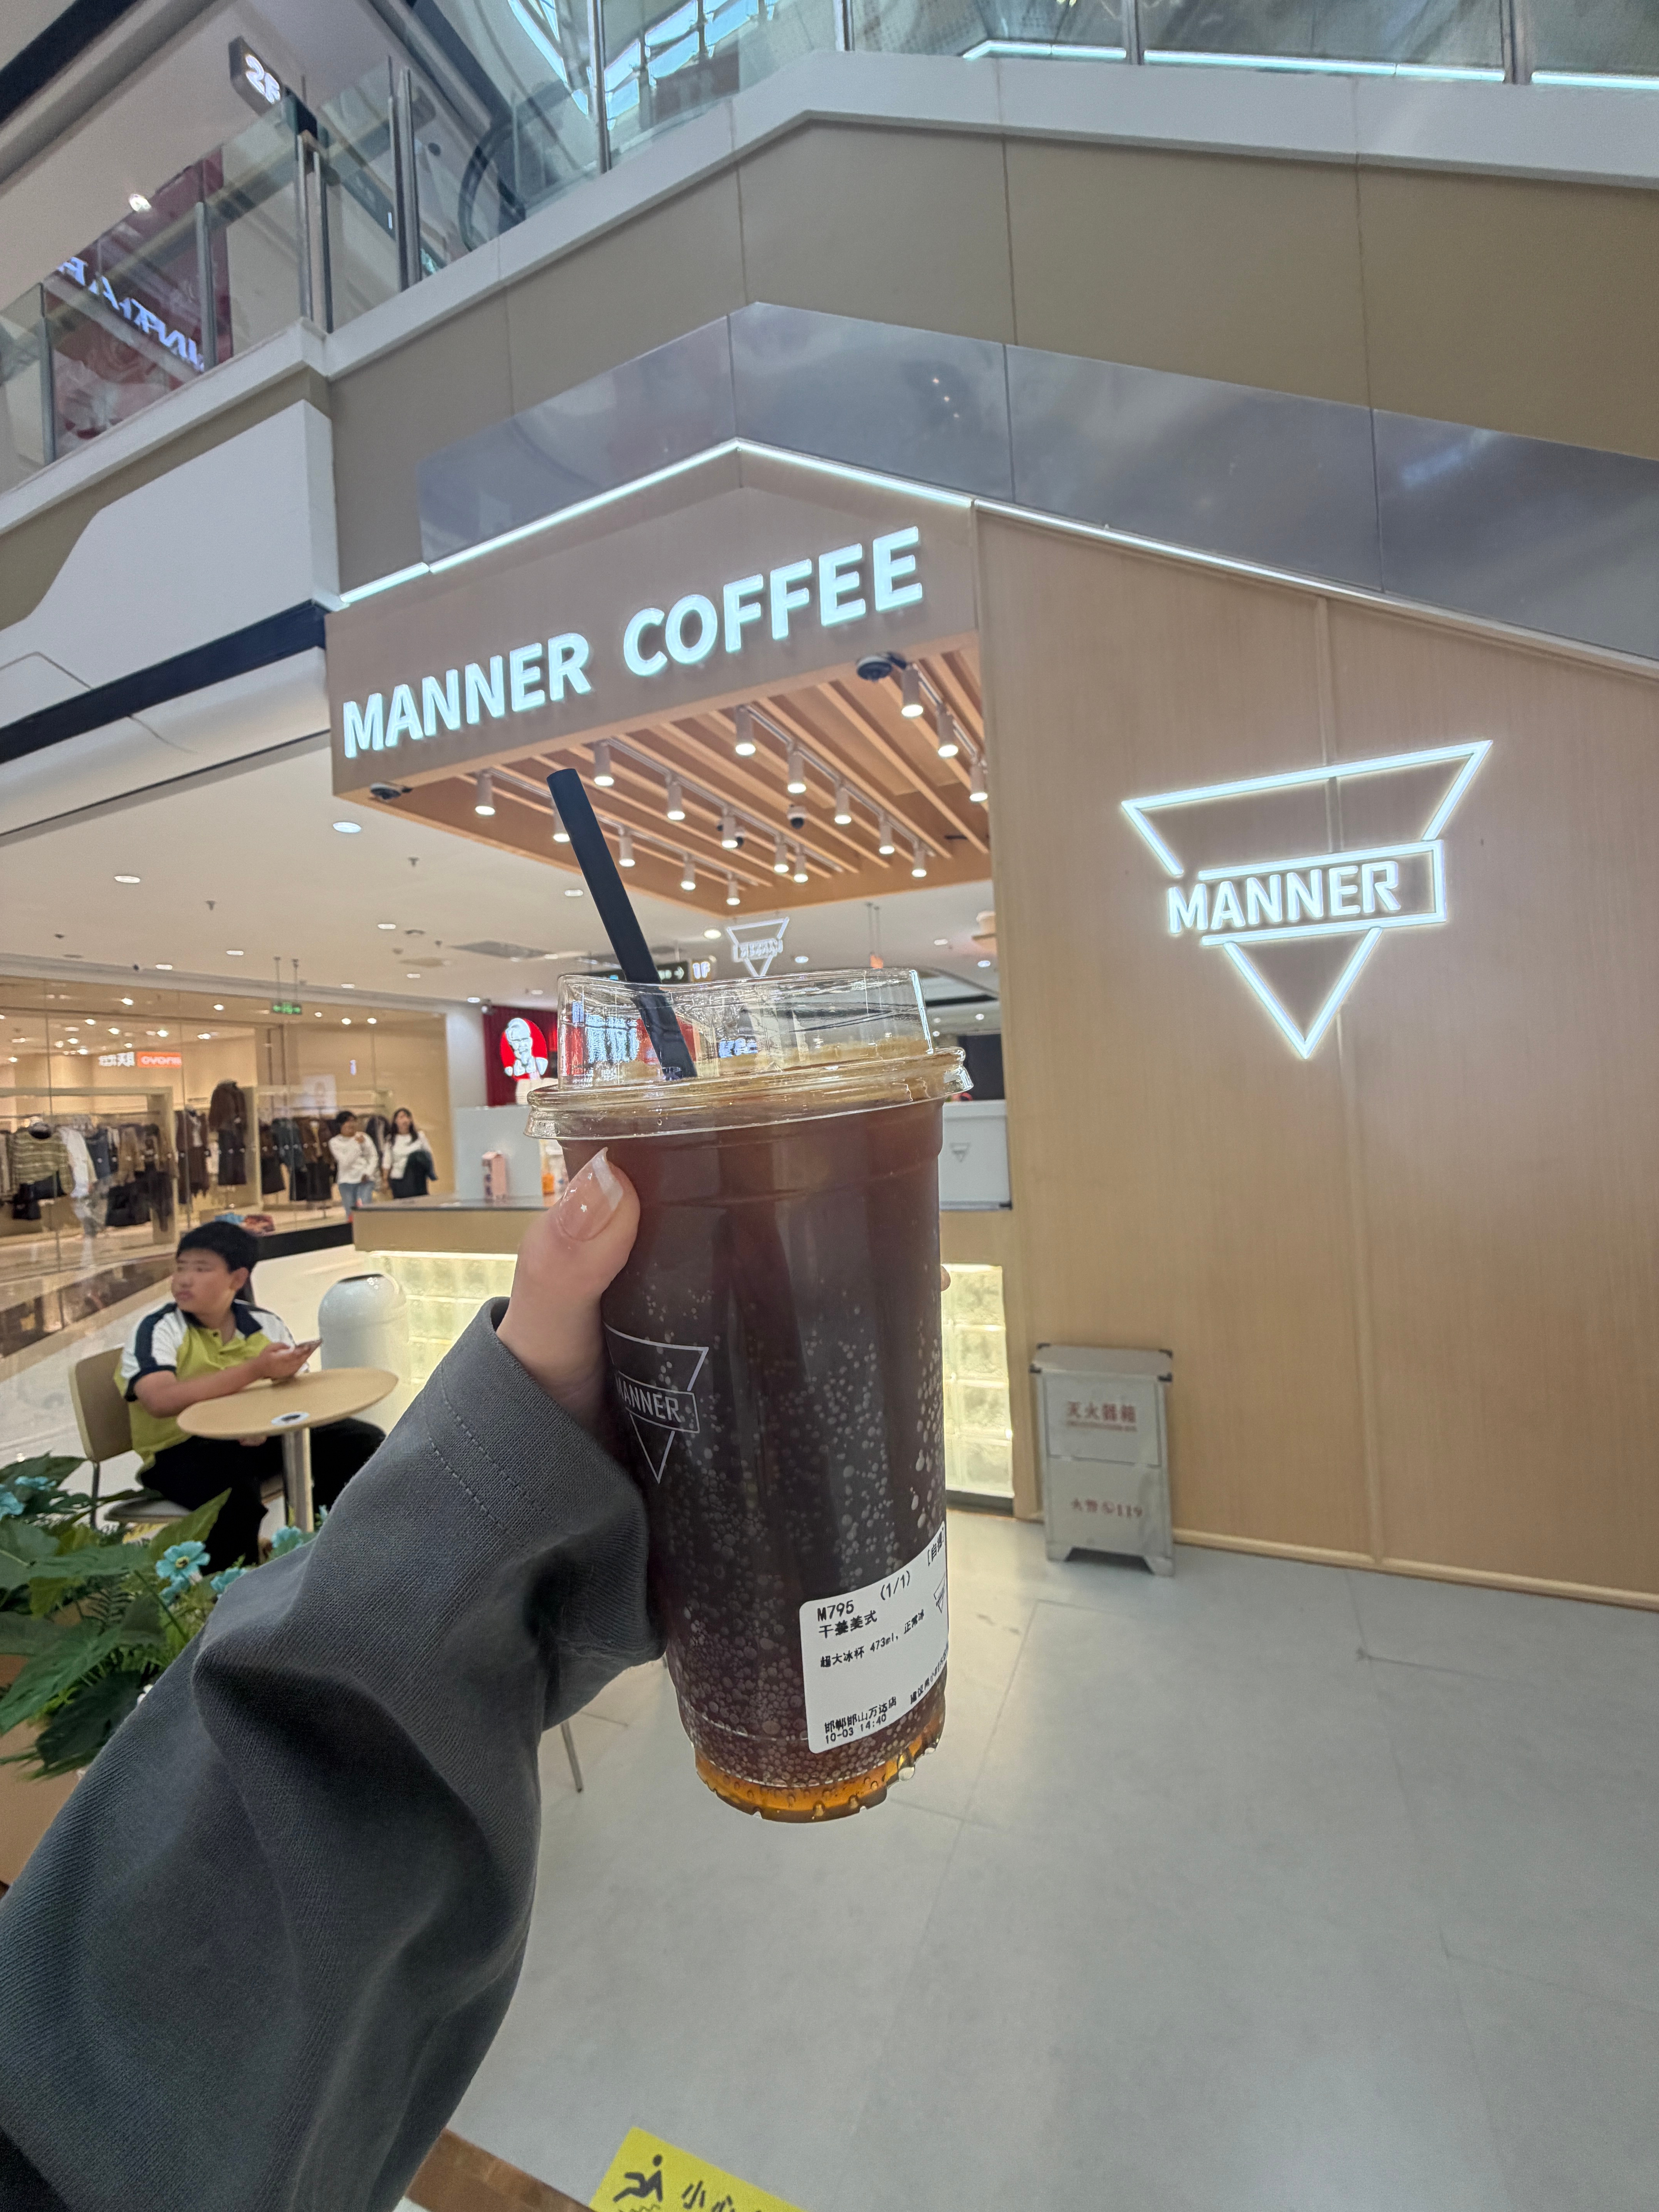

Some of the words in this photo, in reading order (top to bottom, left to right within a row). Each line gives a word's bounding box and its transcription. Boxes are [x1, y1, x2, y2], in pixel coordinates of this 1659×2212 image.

[343, 632, 591, 758] MANNER
[623, 526, 922, 676] COFFEE
[1168, 861, 1401, 934] MANNER
[693, 962, 711, 979] 1F
[817, 1600, 854, 1621] M795
[881, 1570, 910, 1600] (1/1)
[821, 1646, 864, 1668] 超大冰杯
[826, 1727, 854, 1744] 10-03
[860, 1714, 886, 1732] 14:40
